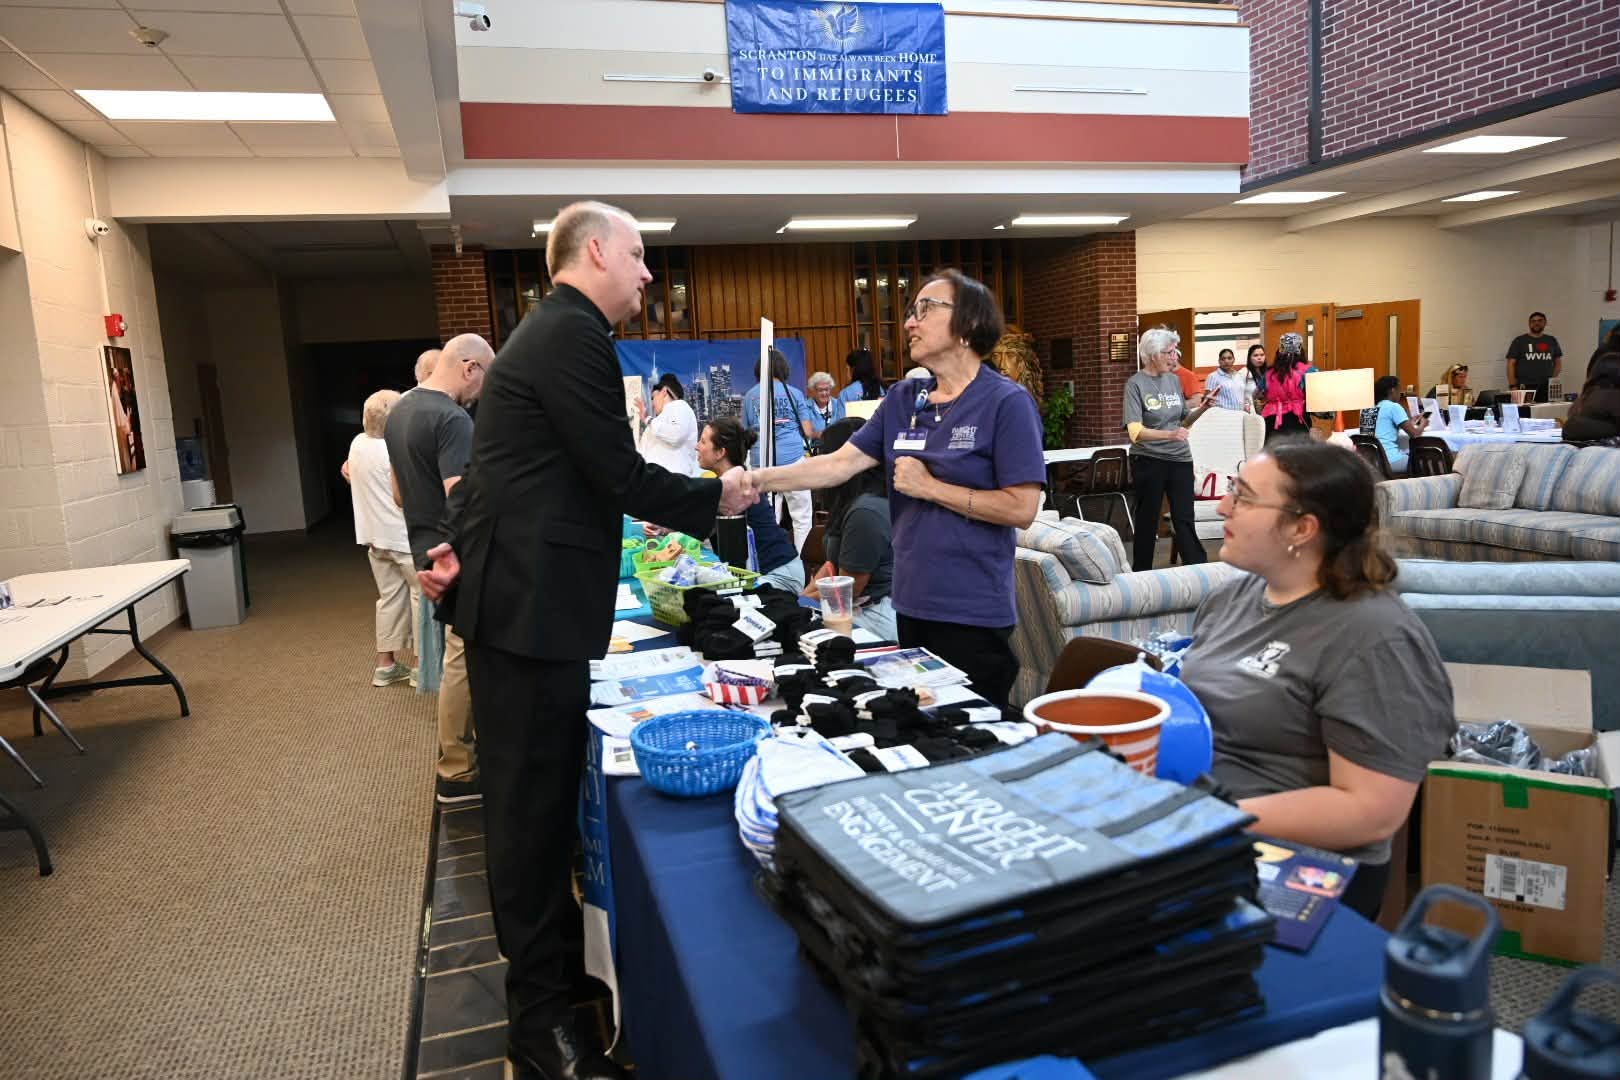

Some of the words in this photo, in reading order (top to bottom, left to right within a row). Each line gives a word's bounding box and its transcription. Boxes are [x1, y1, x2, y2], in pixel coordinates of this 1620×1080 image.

[739, 49, 816, 61] SCRANTON
[819, 54, 837, 62] HAS
[839, 54, 873, 62] ALWAYS
[874, 55, 896, 63] BEEN
[899, 53, 937, 64] HOME
[757, 67, 784, 80] TO
[794, 67, 923, 83] IMMIGRANTS
[767, 87, 808, 101] AND
[817, 87, 917, 102] REFUGEES
[904, 789, 1035, 870] CENTER
[943, 782, 1089, 859] WRIGHT
[823, 800, 958, 892] ENGAGEMENT
